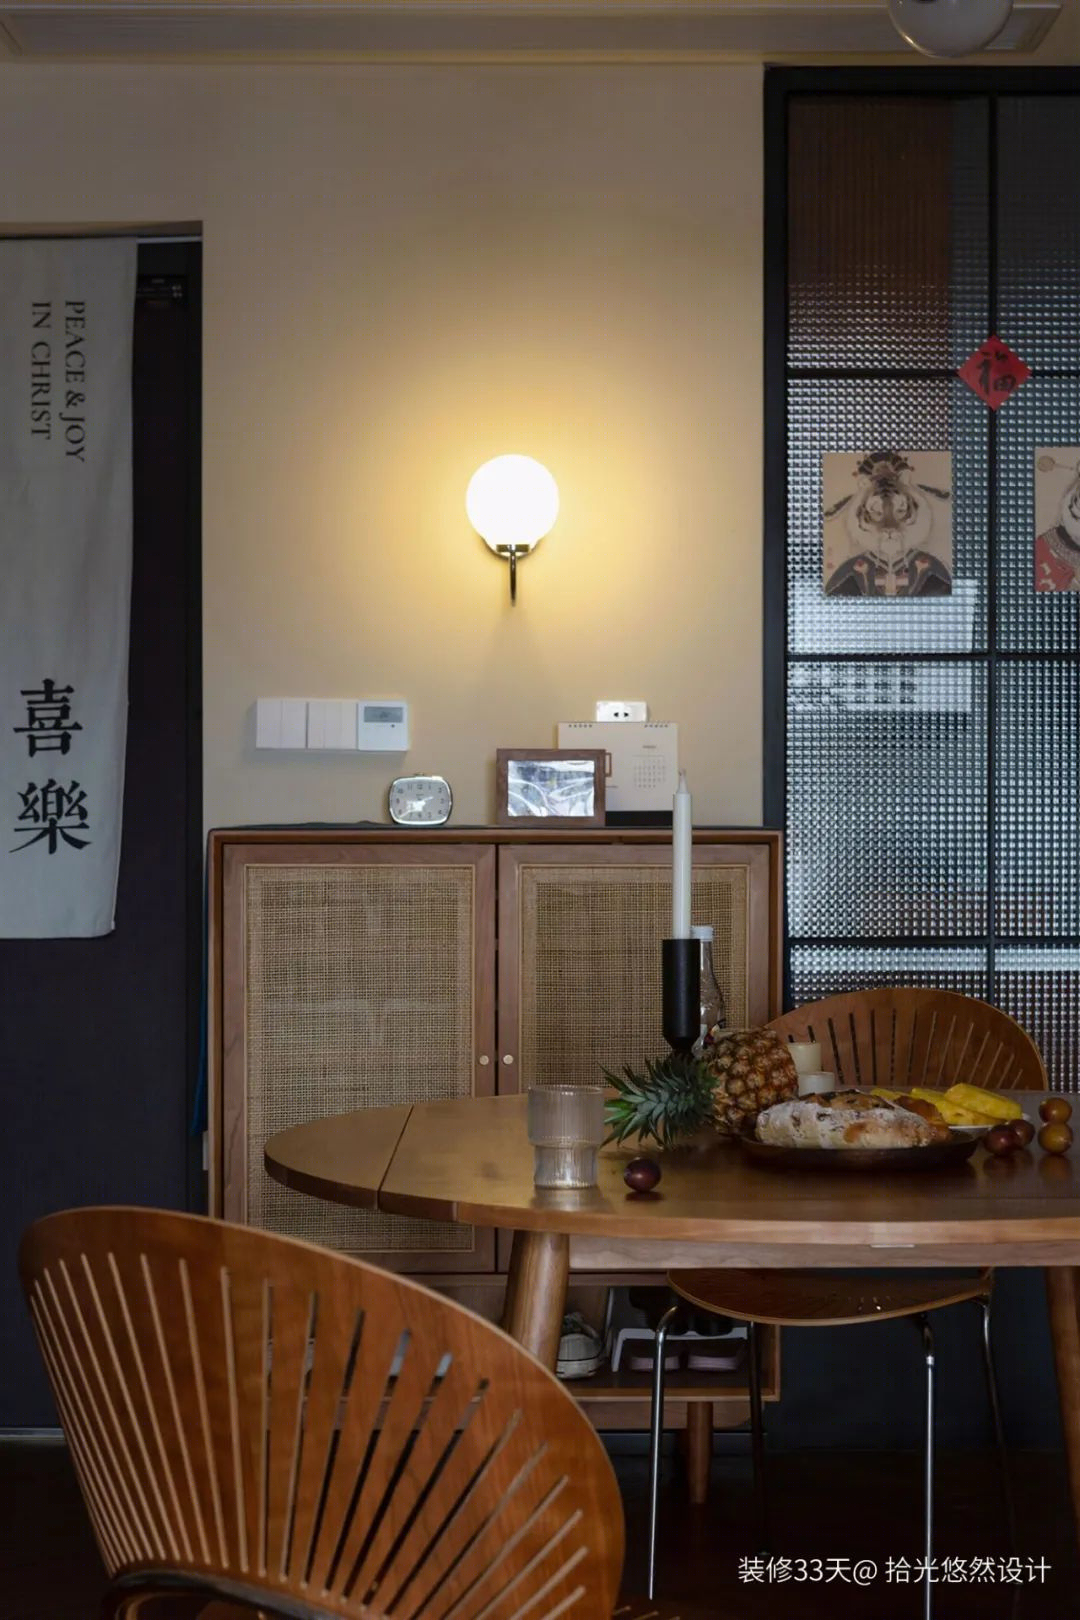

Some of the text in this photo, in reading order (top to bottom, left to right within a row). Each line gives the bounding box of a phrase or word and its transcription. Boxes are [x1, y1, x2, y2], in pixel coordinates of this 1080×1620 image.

[31, 302, 51, 440] IN CHRIST
[59, 301, 85, 463] PEACE & JOY
[9, 678, 92, 855] 喜樂
